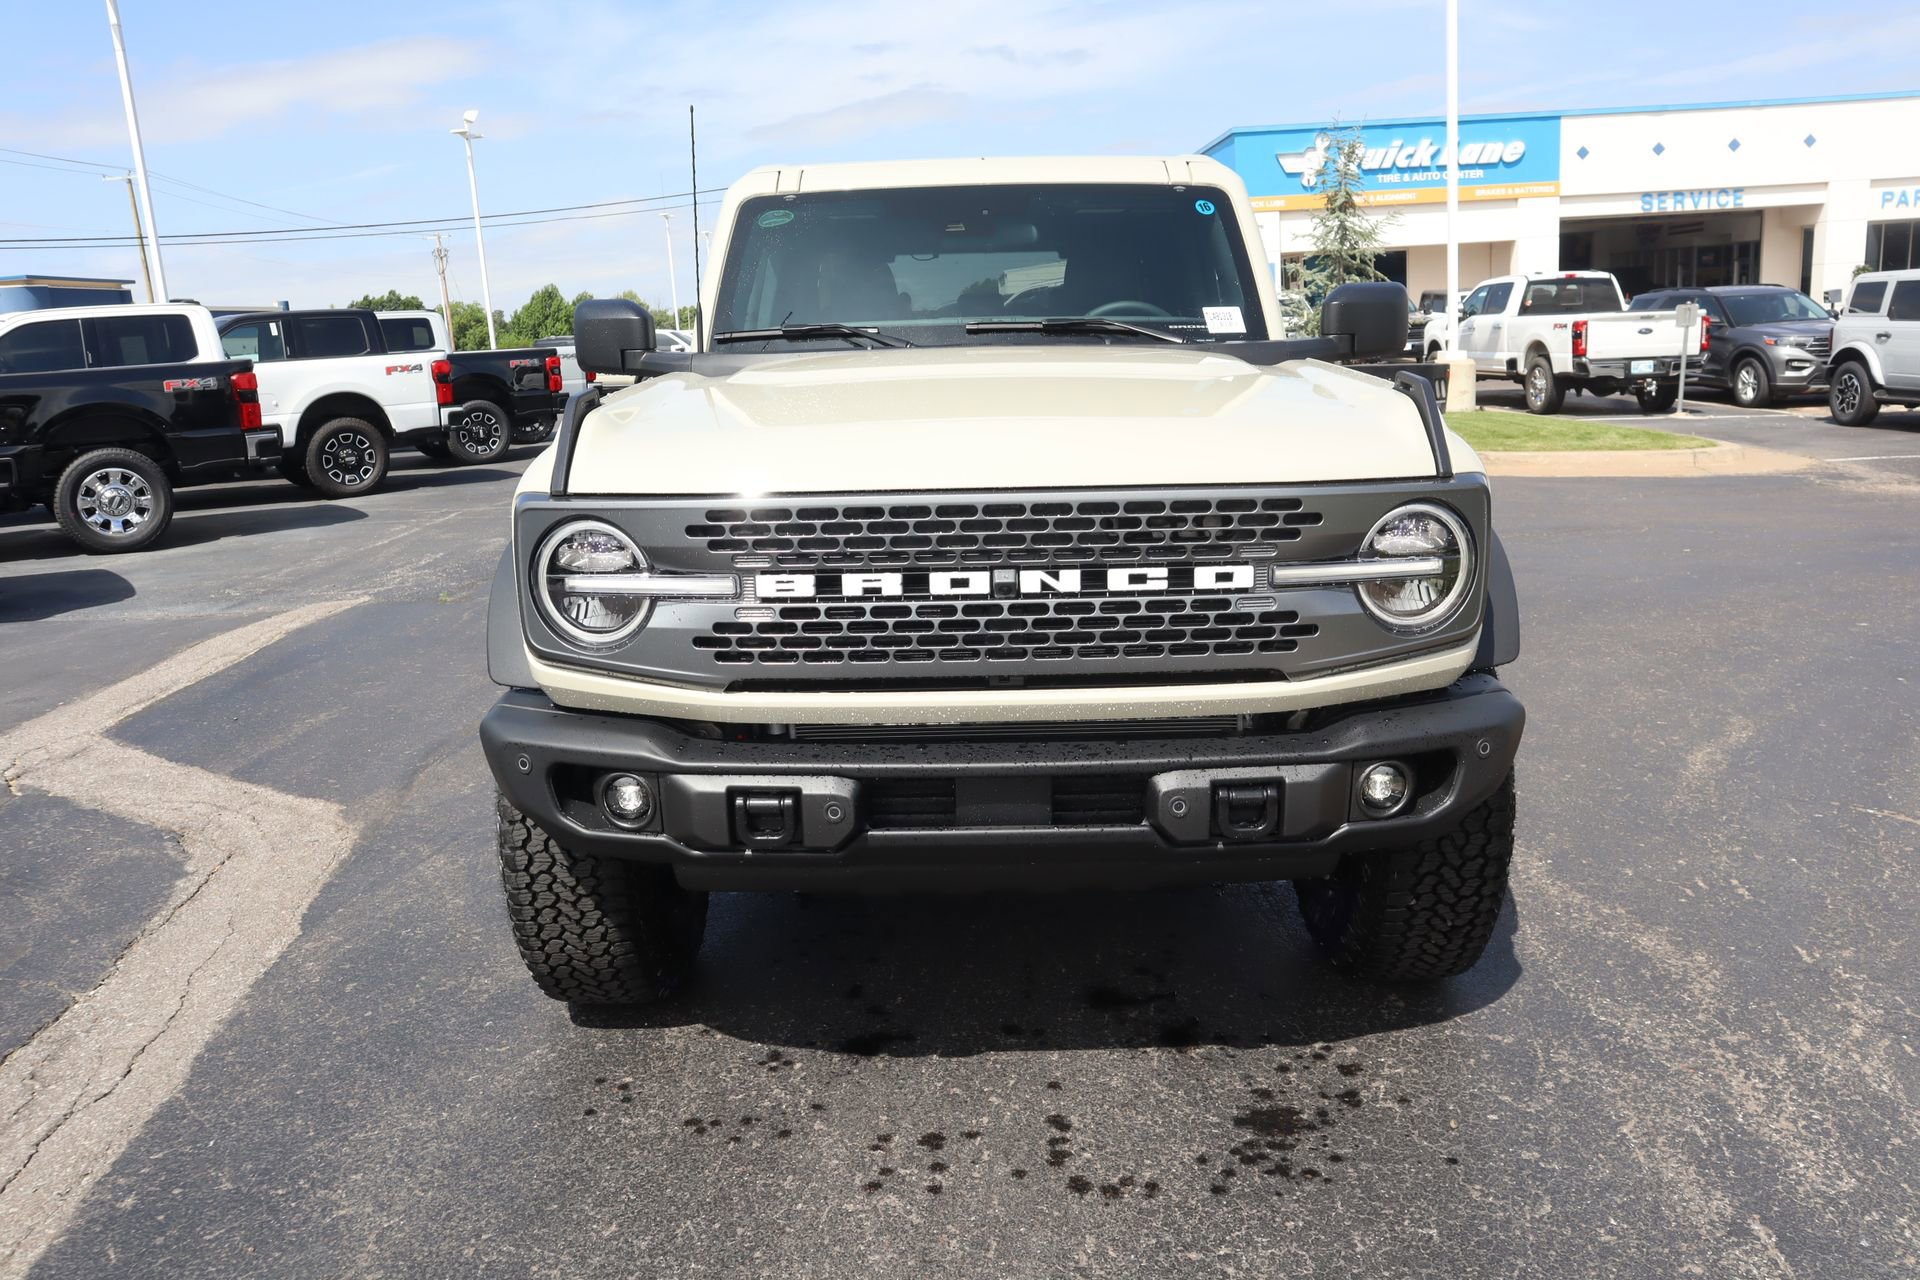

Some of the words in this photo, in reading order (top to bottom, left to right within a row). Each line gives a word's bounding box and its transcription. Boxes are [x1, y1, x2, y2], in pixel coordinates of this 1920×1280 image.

[1376, 174, 1401, 183] TIRE
[1403, 173, 1410, 182] &
[1409, 171, 1440, 181] AUTO
[1443, 169, 1484, 180] CNTER
[1197, 202, 1212, 212] 16
[1640, 188, 1745, 212] SERVICE
[385, 363, 423, 375] FX4
[509, 358, 540, 368] FX4
[163, 377, 218, 393] FX4
[754, 564, 1256, 598] BRONCO
